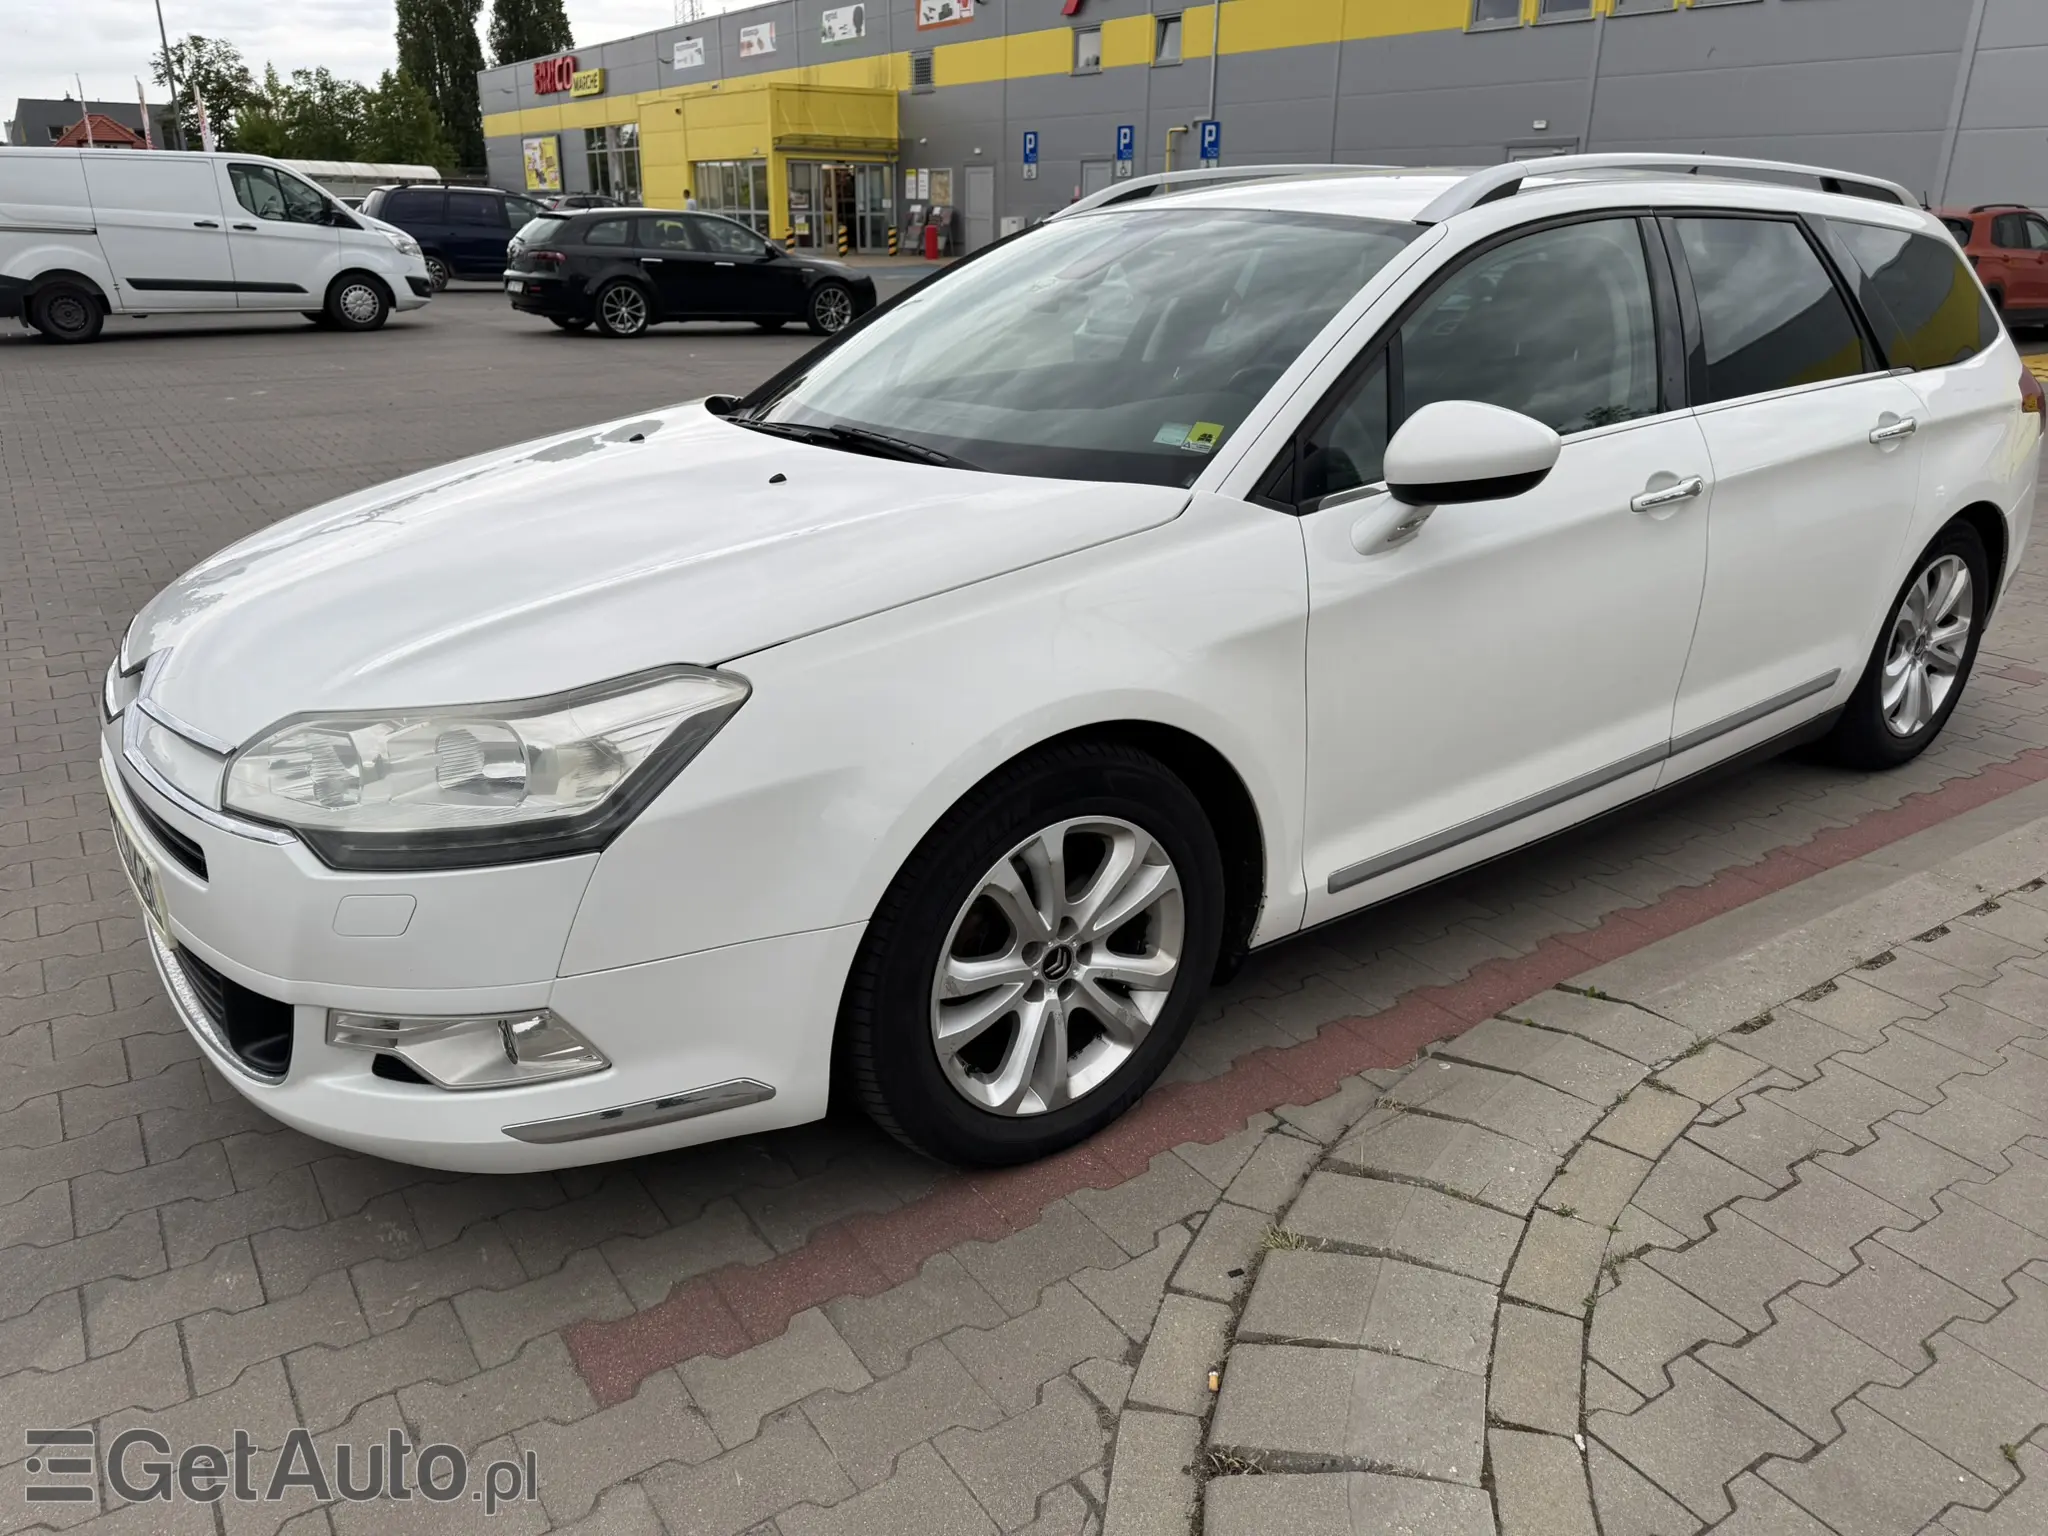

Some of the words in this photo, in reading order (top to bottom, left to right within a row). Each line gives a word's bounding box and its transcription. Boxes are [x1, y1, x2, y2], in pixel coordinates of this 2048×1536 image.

[534, 55, 577, 95] BRICO
[1025, 133, 1036, 155] P
[1120, 127, 1131, 150] P
[1204, 124, 1217, 148] P
